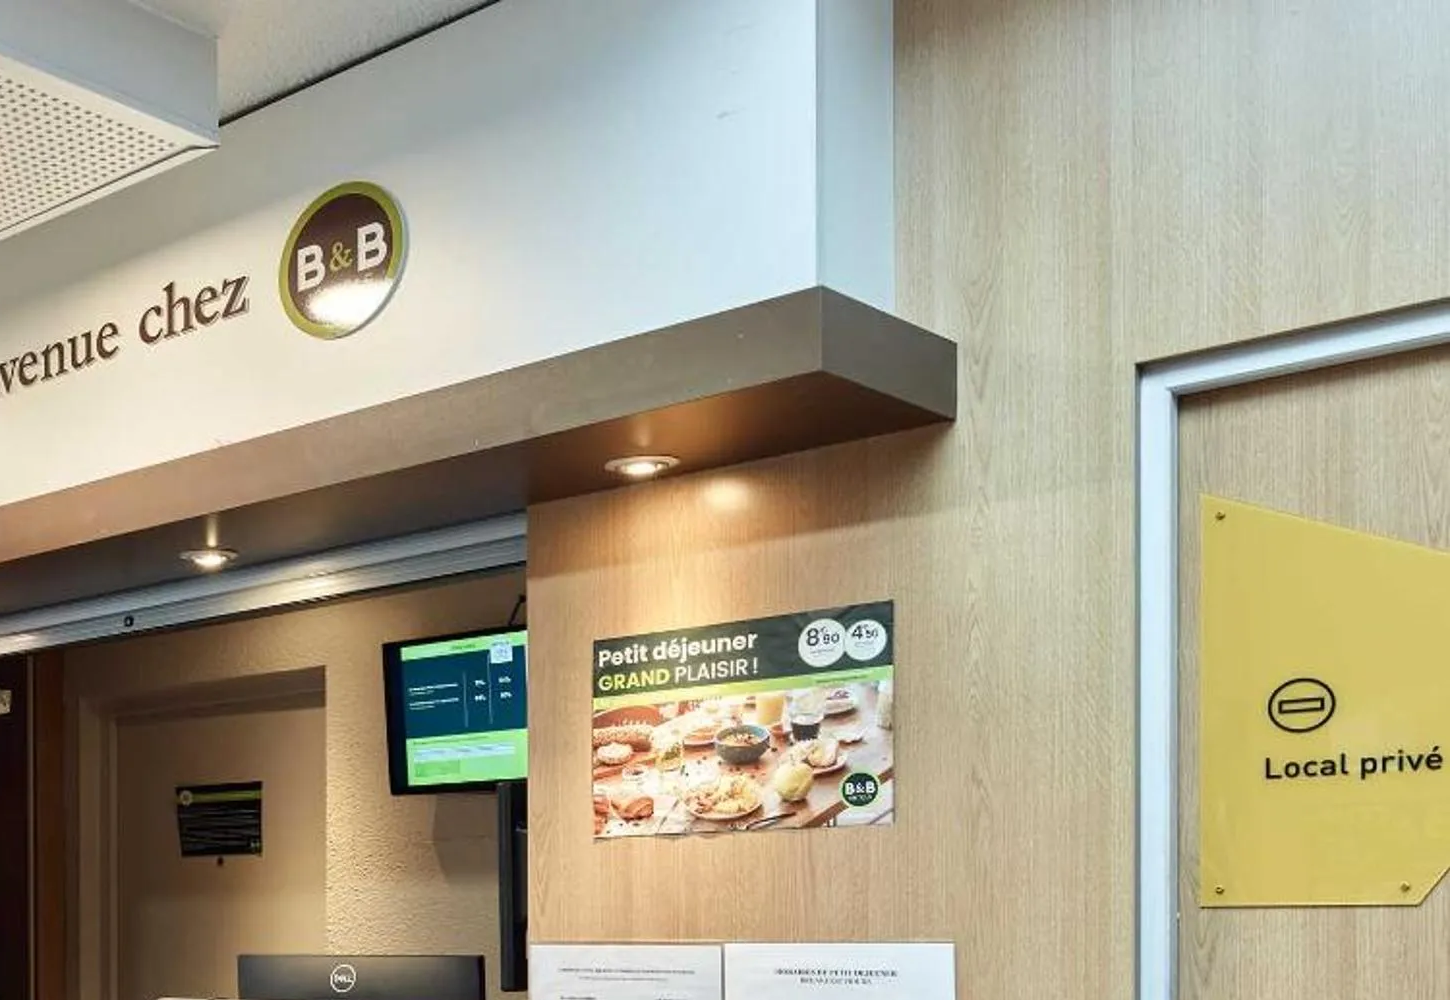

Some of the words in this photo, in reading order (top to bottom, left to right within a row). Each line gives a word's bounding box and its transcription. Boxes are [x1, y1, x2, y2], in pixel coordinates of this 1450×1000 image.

[296, 221, 388, 292] B&B
[138, 274, 250, 346] chez
[598, 643, 648, 668] Petit
[652, 633, 758, 664] déjeuner
[598, 668, 670, 691] GRAND
[674, 658, 748, 683] PLAISIR
[1264, 752, 1349, 780] Local
[1360, 745, 1444, 780] privé
[845, 781, 876, 795] B&B
